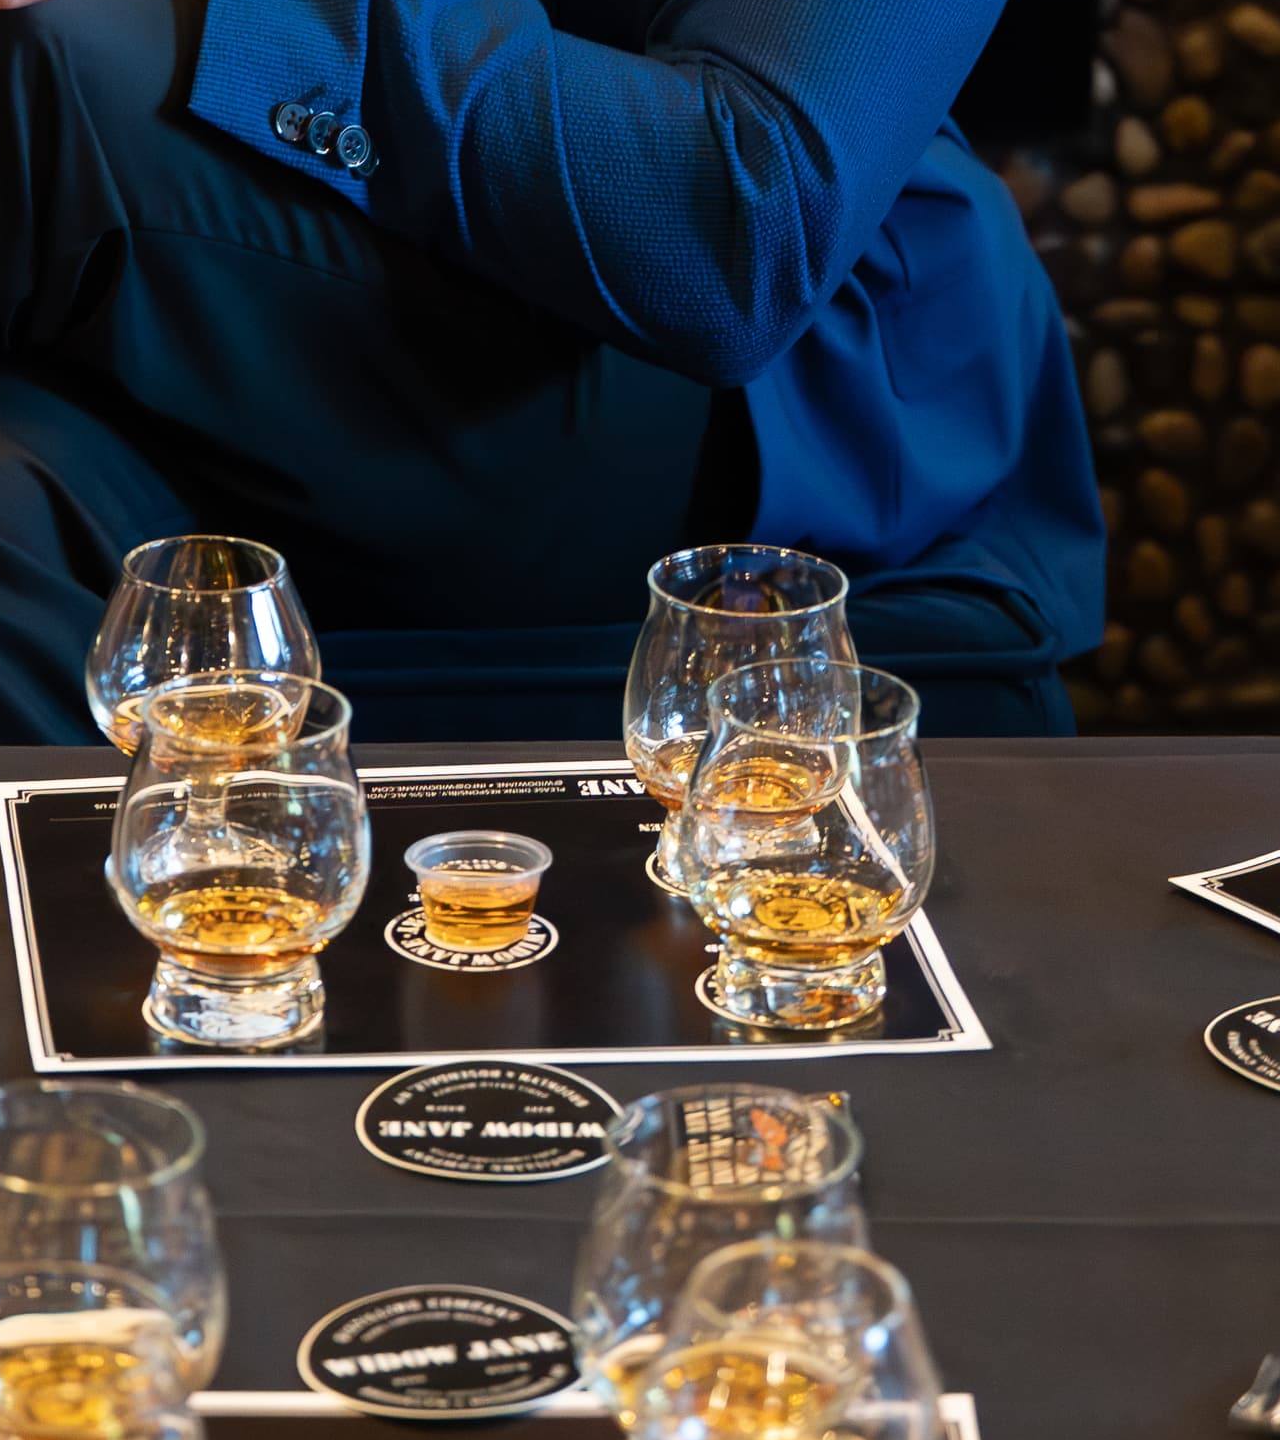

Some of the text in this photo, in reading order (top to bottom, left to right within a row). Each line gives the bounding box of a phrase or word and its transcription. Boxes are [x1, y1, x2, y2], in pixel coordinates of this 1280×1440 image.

[578, 777, 647, 797] ANE
[378, 1120, 607, 1138] WIDOW JANE
[321, 1330, 569, 1379] WIDOW JANE
